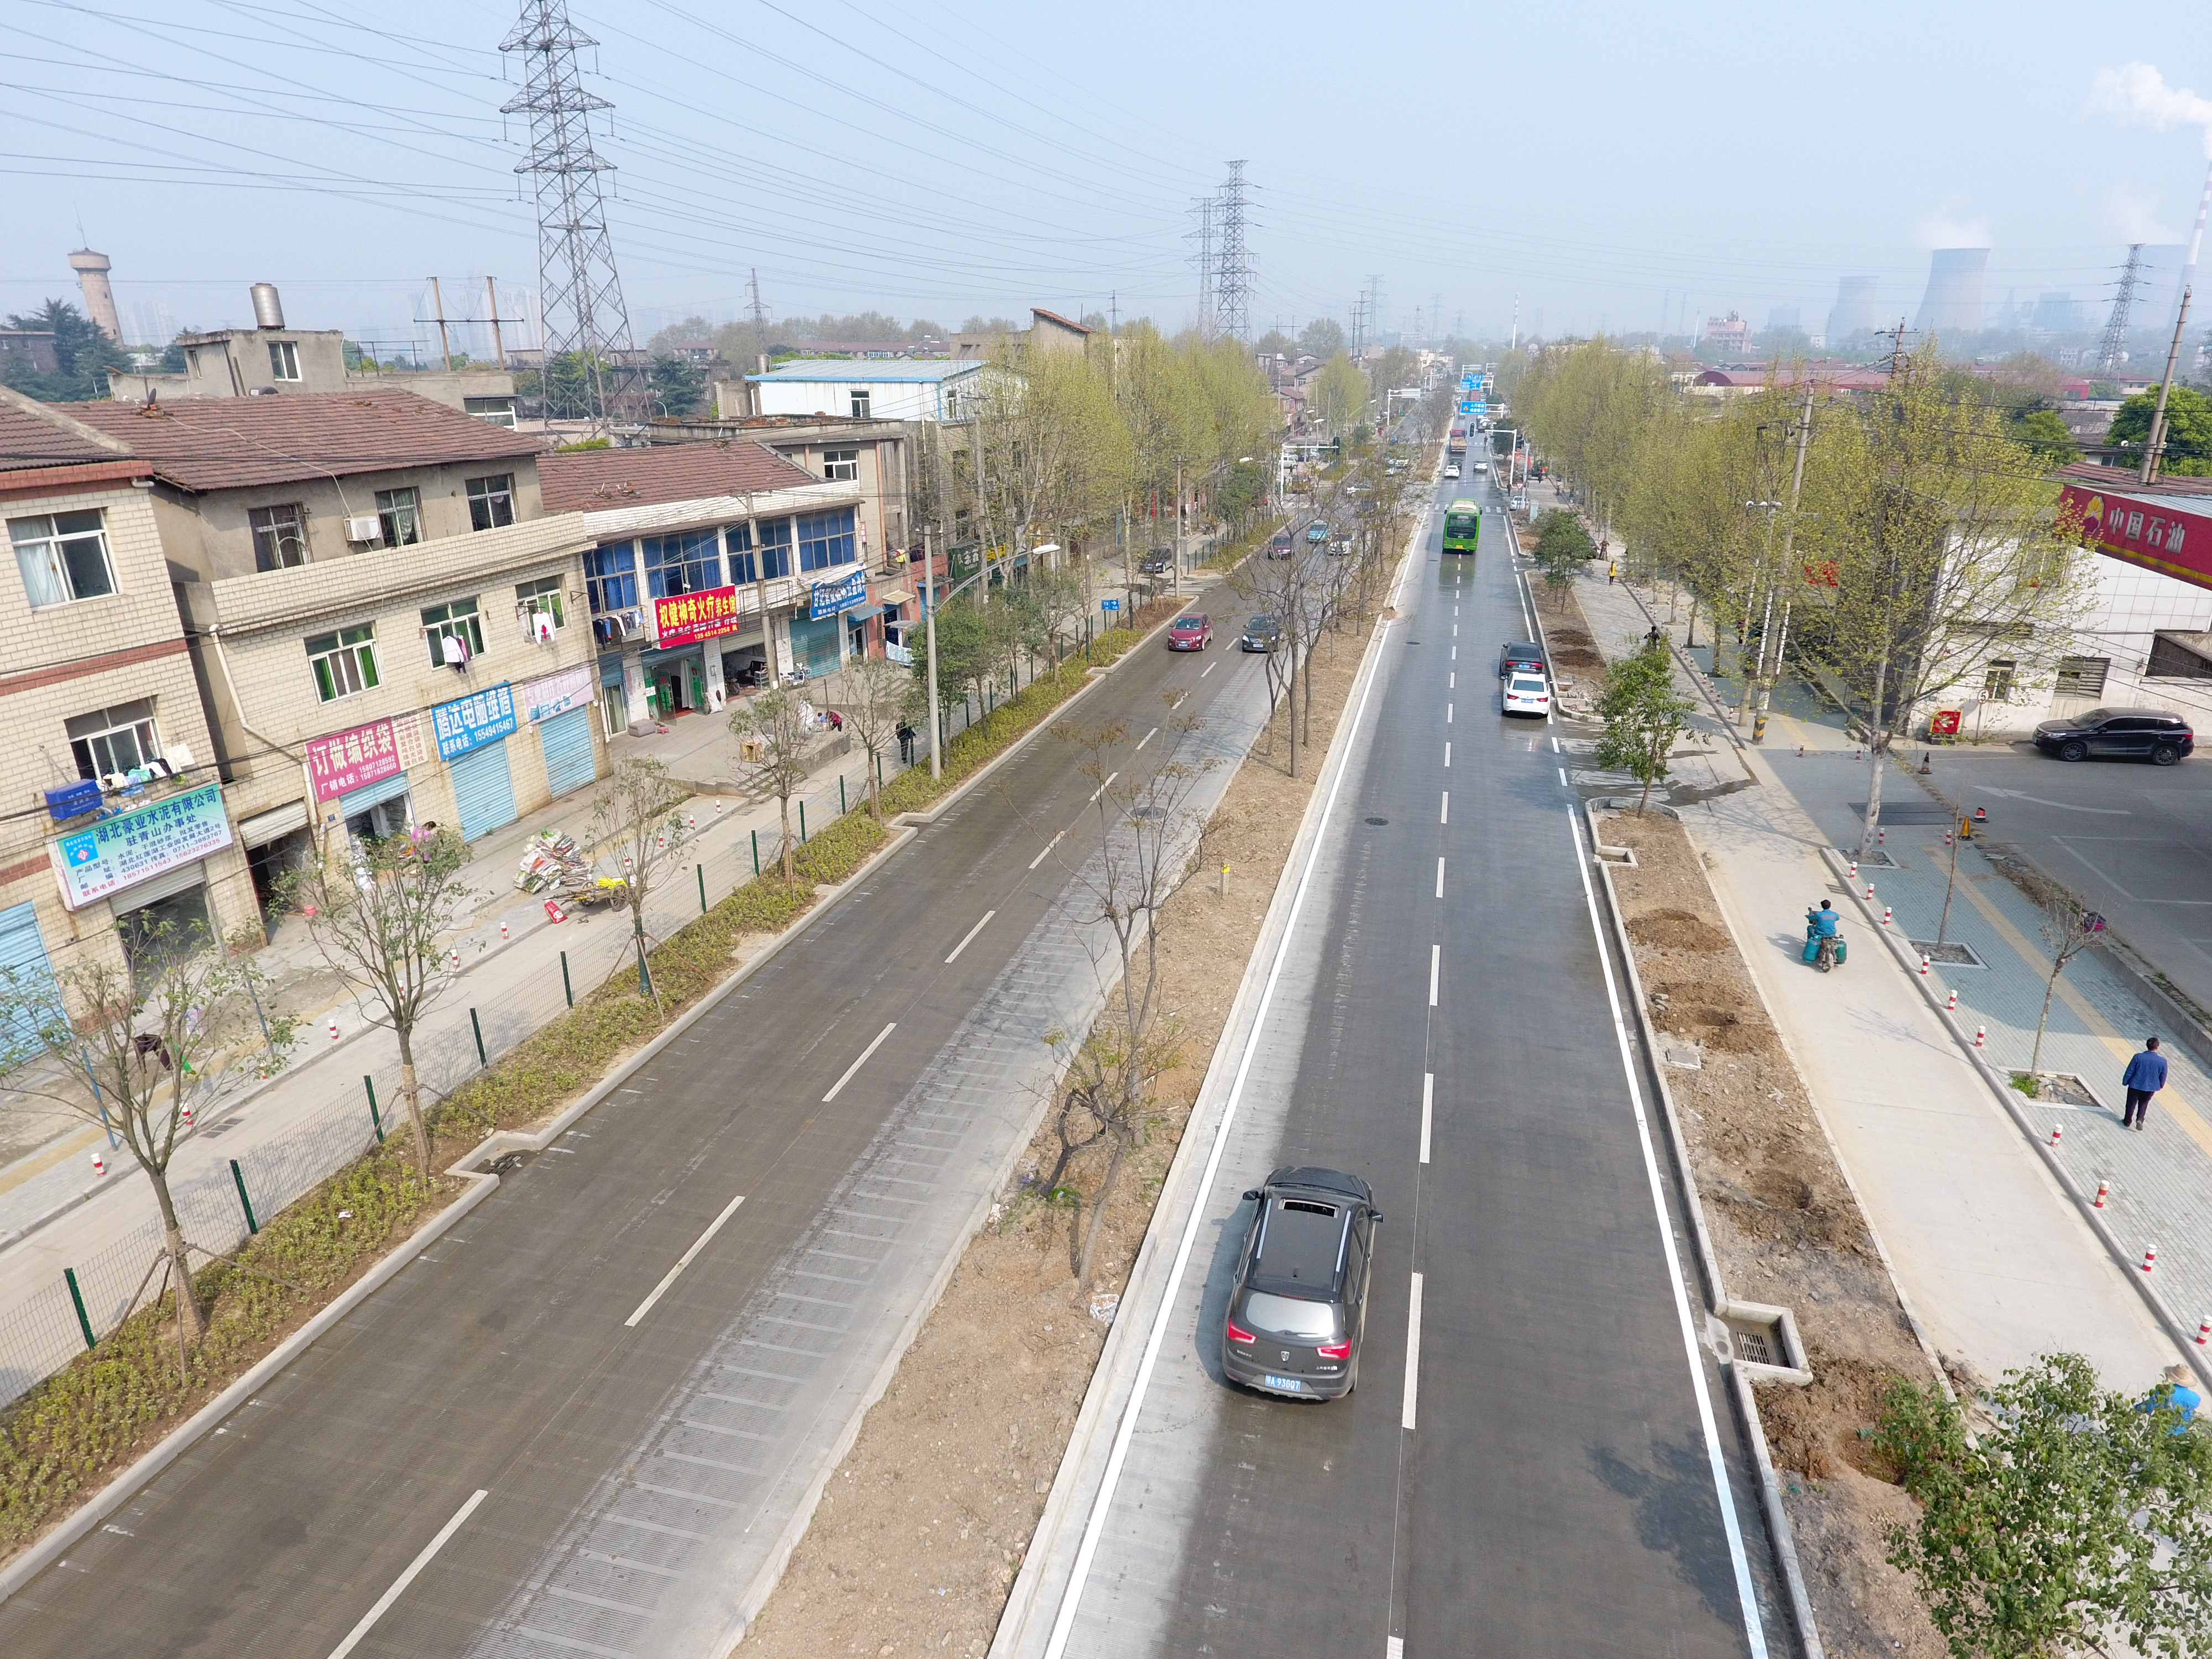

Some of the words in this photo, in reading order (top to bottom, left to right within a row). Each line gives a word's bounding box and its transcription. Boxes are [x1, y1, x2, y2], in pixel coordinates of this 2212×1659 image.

[2109, 507, 2185, 554] 中国石油
[1980, 691, 1986, 702] 5
[435, 687, 512, 741] 腾达电脑维修
[474, 718, 513, 742] 15549415467
[312, 723, 393, 776] 订做编织袋
[359, 755, 395, 774] 15807128592
[360, 762, 397, 781] 15871828660
[96, 789, 216, 844] 湖北豪业水泥有限公司
[126, 813, 197, 847] 驻青山办事处
[121, 859, 148, 874] 430631
[123, 858, 171, 880] 18571511543
